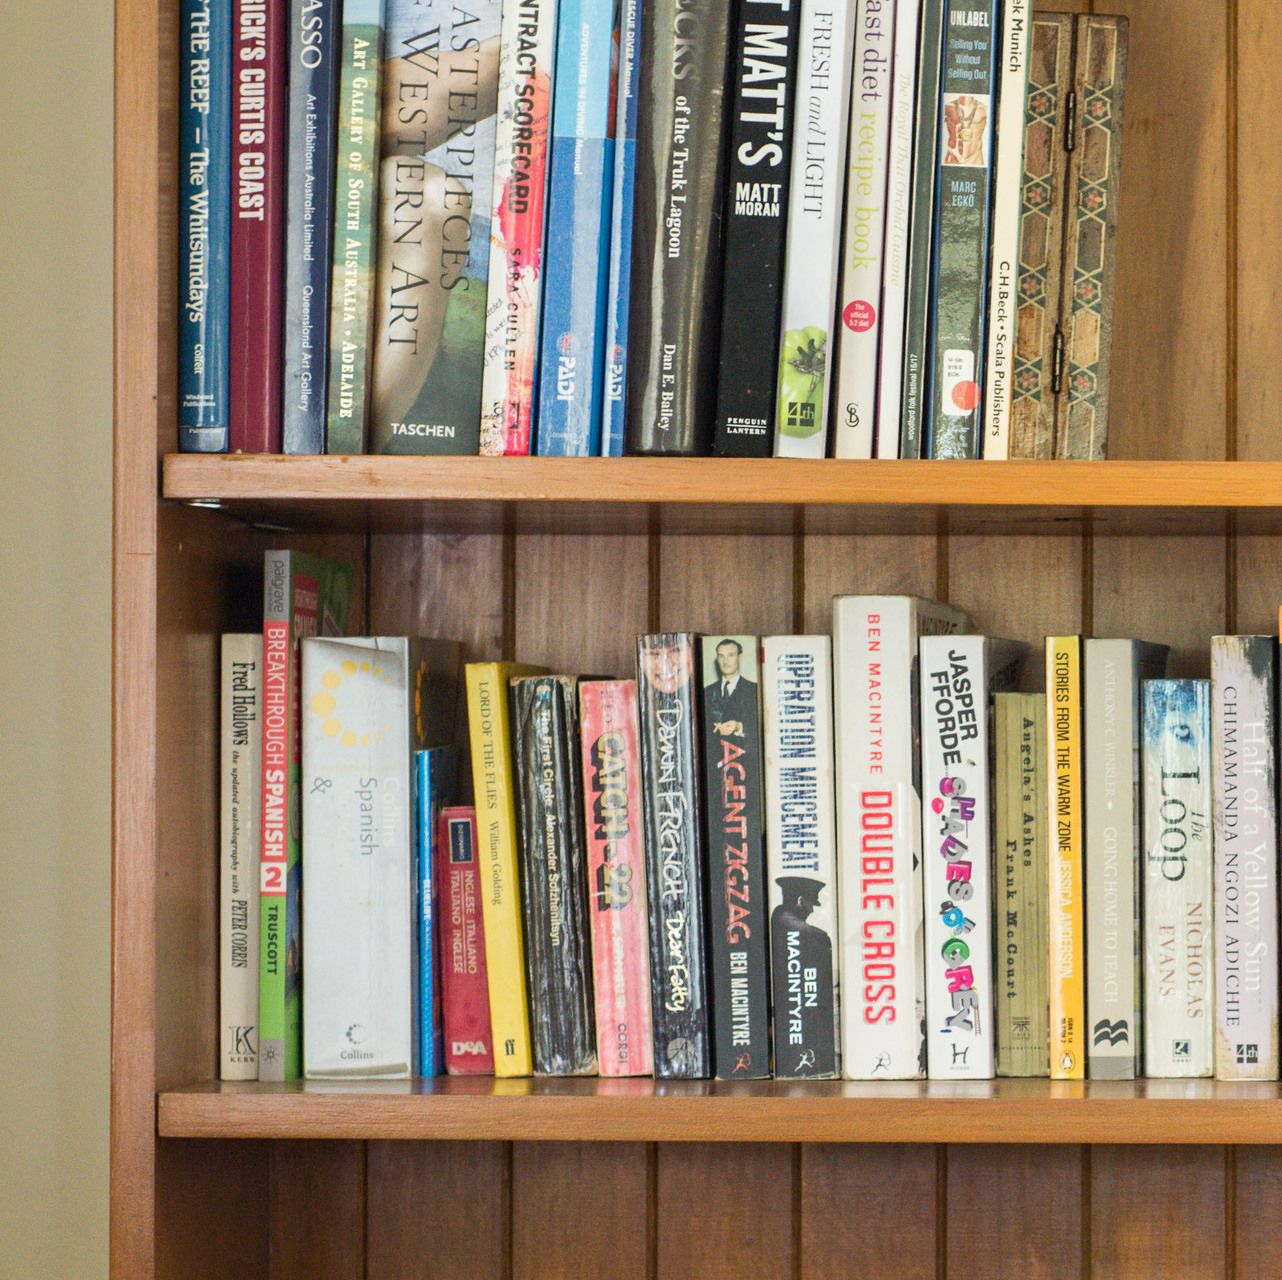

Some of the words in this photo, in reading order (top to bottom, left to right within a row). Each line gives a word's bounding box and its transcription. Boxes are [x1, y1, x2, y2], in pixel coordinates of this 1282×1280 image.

[191, 8, 209, 52] THE
[1009, 19, 1023, 72] Munich
[191, 59, 209, 113] REEF
[240, 68, 266, 144] CURTIS
[306, 94, 317, 111] Art
[737, 22, 790, 167] MATT'S
[304, 113, 316, 170] Exhibitions
[508, 84, 535, 214] SCORECARD
[189, 148, 208, 190] The
[239, 152, 264, 221] COAST
[736, 182, 781, 201] MATT
[304, 174, 315, 220] Australia
[735, 201, 780, 216] MORAN
[185, 191, 208, 322] Whitsundays
[303, 224, 314, 261] Limited
[508, 248, 521, 293] SARA
[997, 261, 1010, 322] C.H.Beck
[301, 285, 313, 348] Queensland
[504, 303, 518, 371] CULLEN
[301, 352, 311, 368] Art
[995, 334, 1007, 366] Scala
[299, 372, 312, 412] Gallery
[992, 371, 1005, 437] Publishers
[391, 423, 455, 437] TASCHEN
[867, 614, 881, 652] BEN
[265, 627, 285, 764] BREAKTHROUGH
[1056, 652, 1069, 702] STORIES
[868, 662, 884, 775] MACINTYRE
[1056, 707, 1070, 742] FROM
[1057, 747, 1070, 769] THE
[264, 769, 284, 856] SPANISH
[1057, 774, 1071, 811] WARM
[861, 790, 894, 910] DOUBLE
[1058, 815, 1071, 852] ZONE
[267, 905, 278, 975] TRUSCOTT
[863, 920, 896, 1025] CROSS
